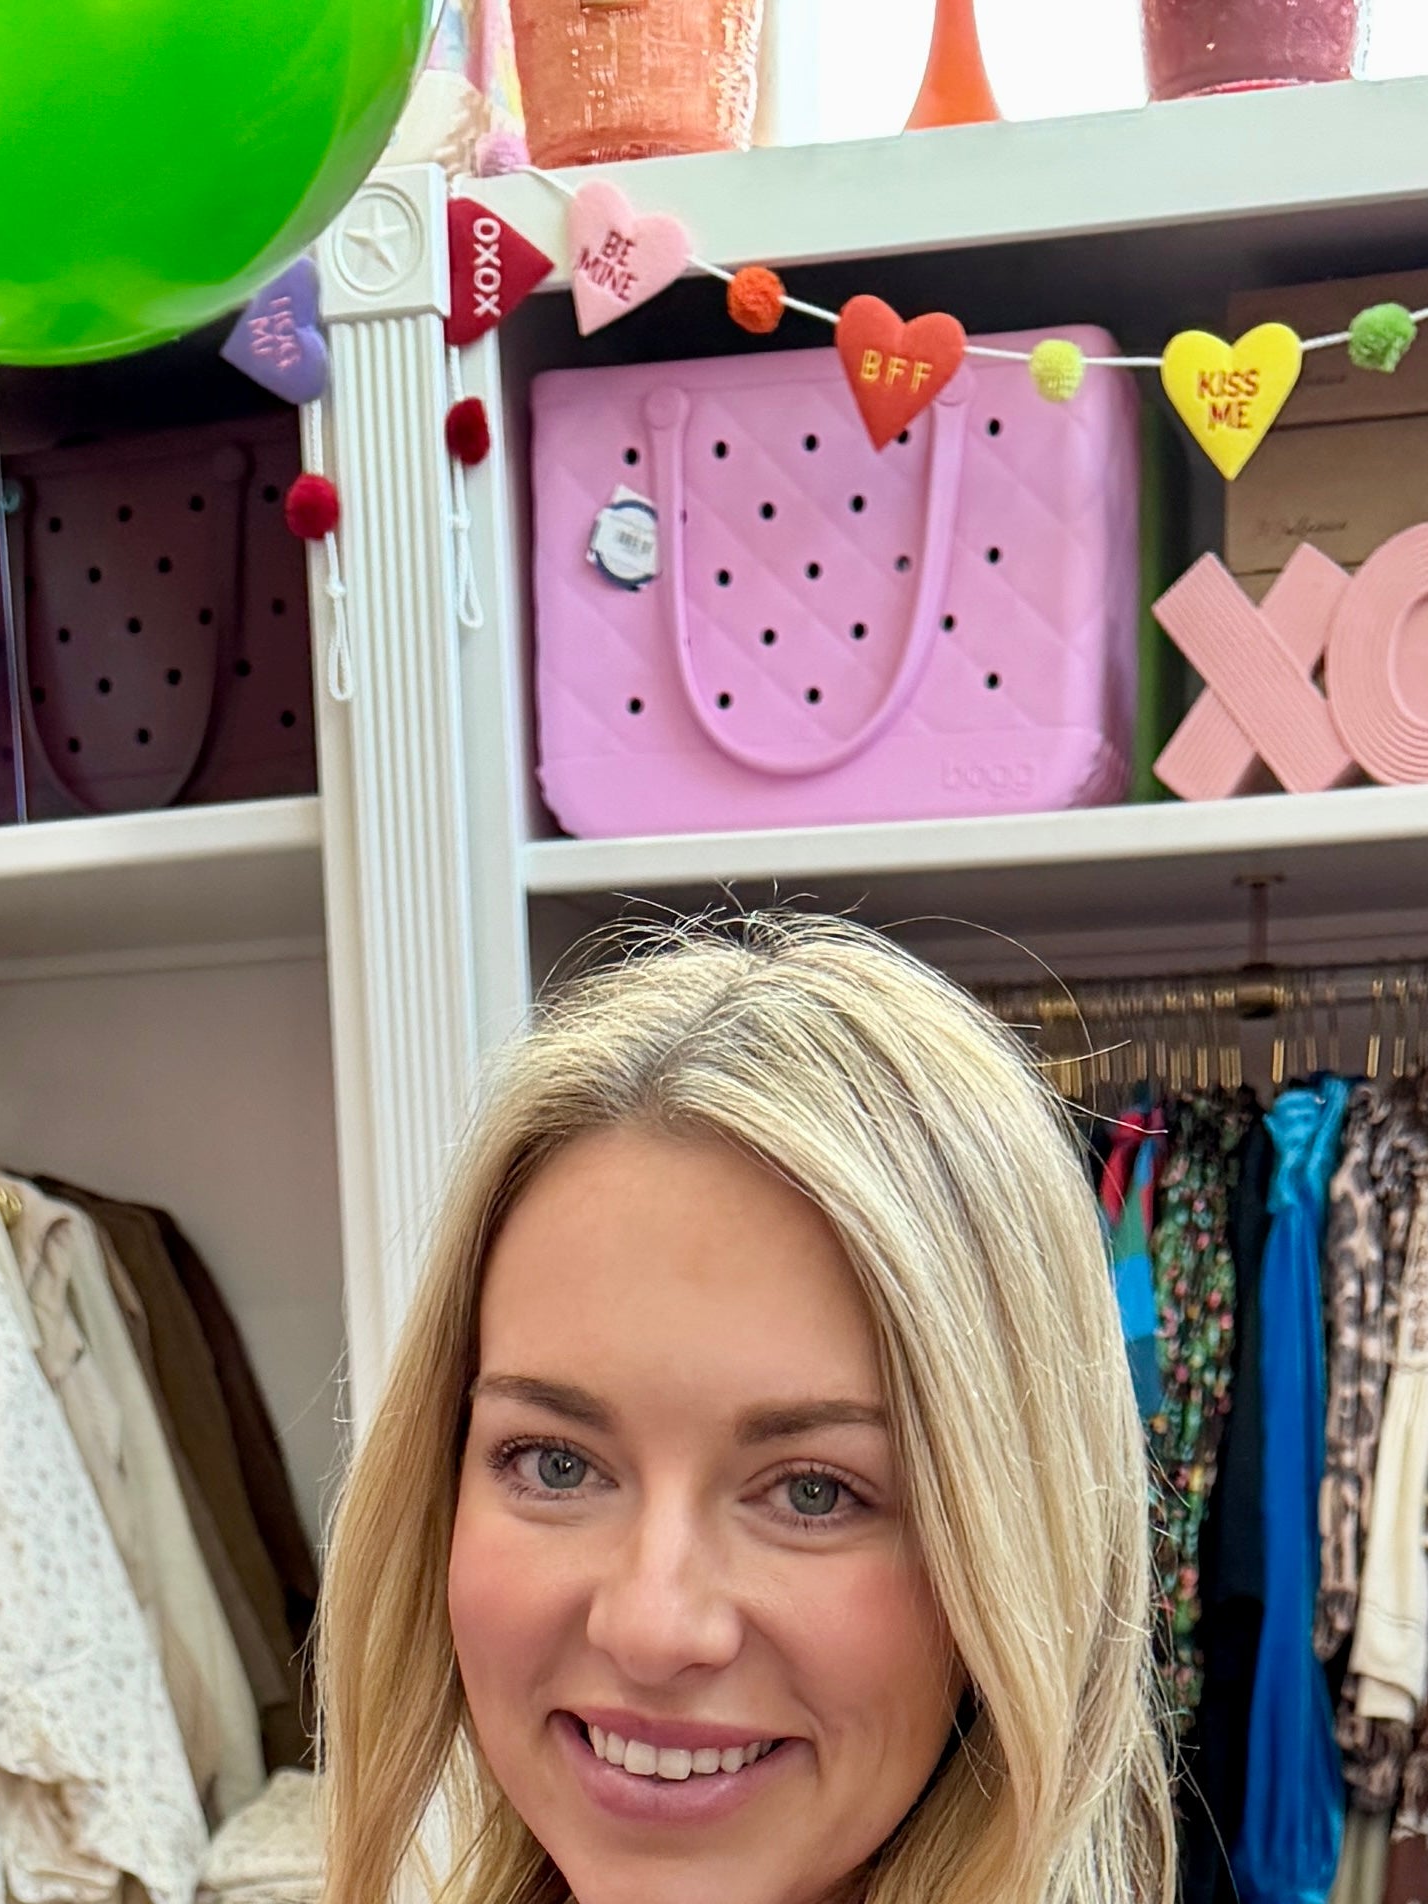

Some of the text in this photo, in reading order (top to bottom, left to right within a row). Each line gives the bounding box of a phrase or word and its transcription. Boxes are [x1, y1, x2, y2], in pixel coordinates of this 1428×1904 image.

[599, 229, 637, 261] BE
[473, 217, 502, 318] XOXO
[576, 254, 638, 302] MINE
[860, 349, 932, 393] BFF
[1196, 368, 1261, 399] KISS
[1207, 400, 1253, 430] ME
[941, 759, 1034, 795] bogg
